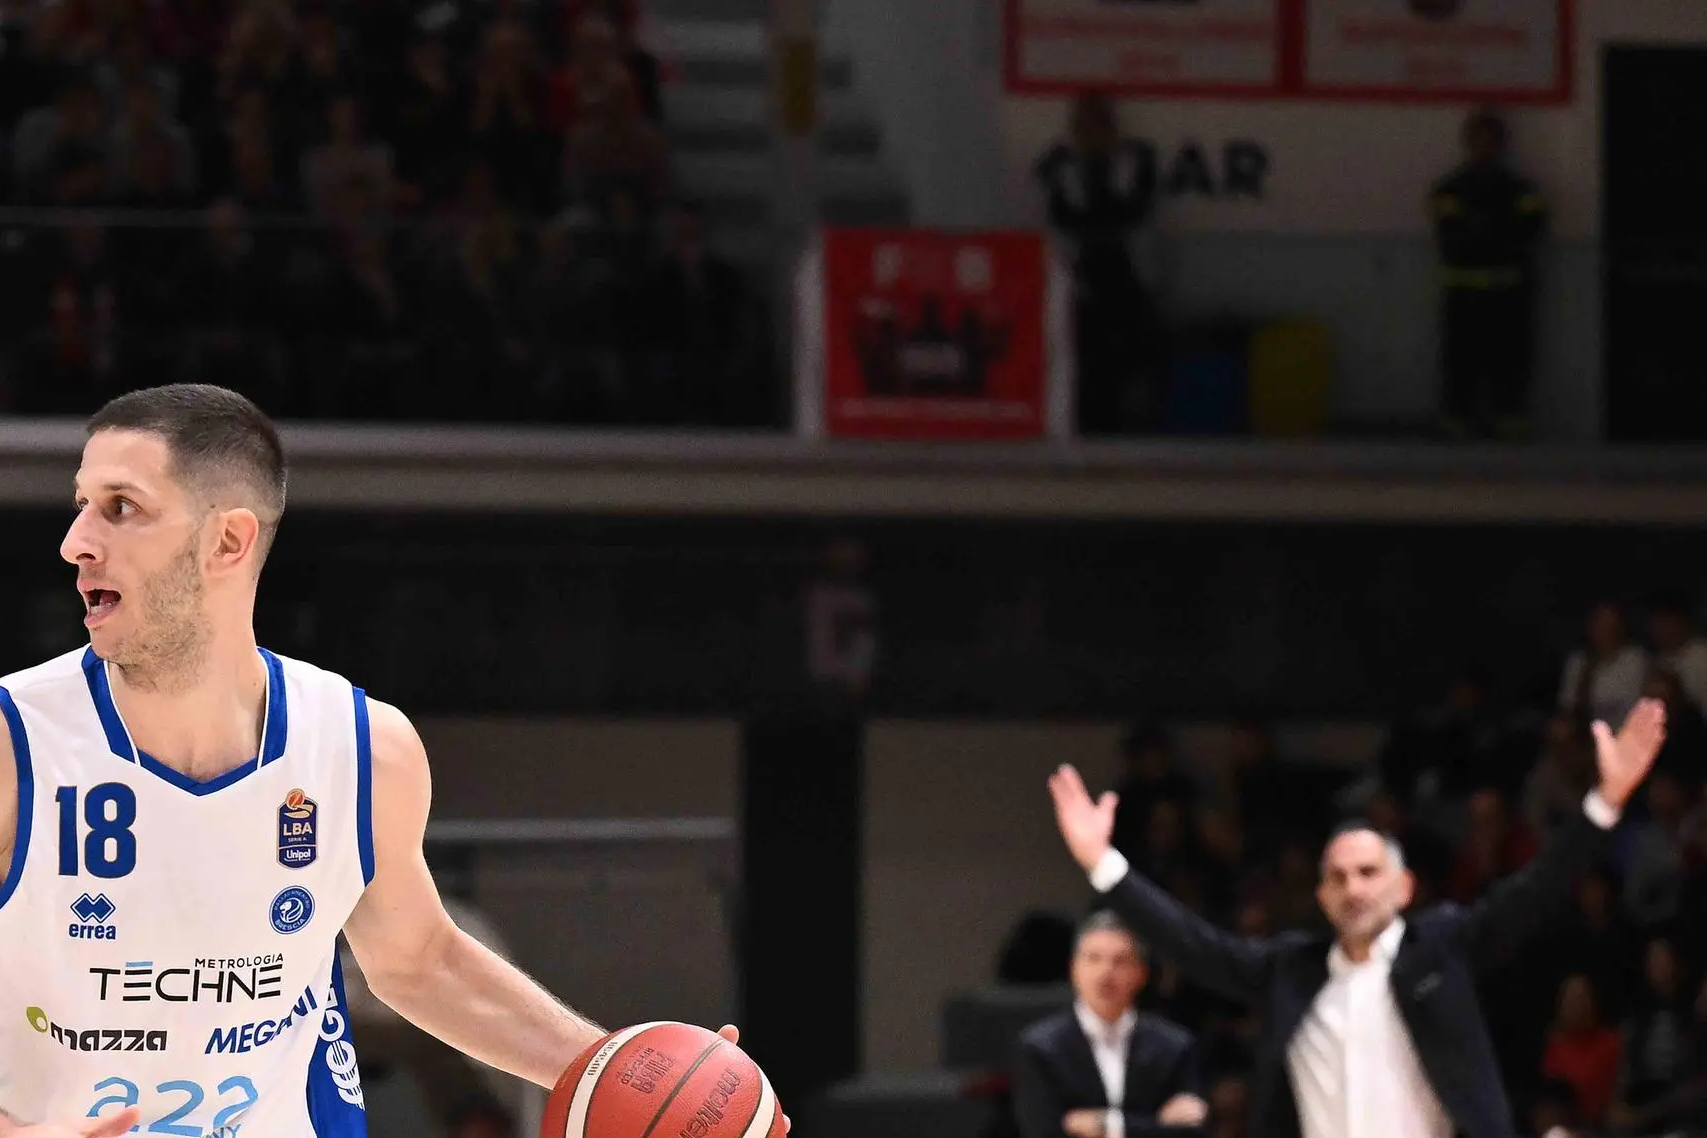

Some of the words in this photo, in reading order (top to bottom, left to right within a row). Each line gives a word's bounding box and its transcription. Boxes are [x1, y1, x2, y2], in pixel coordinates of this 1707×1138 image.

[55, 782, 137, 879] 18
[283, 822, 313, 836] LBA
[286, 848, 311, 861] Unipol
[69, 923, 116, 940] errea
[195, 953, 284, 968] METROLOGIA
[90, 961, 283, 1003] TECHNE
[50, 1021, 168, 1051] mazza
